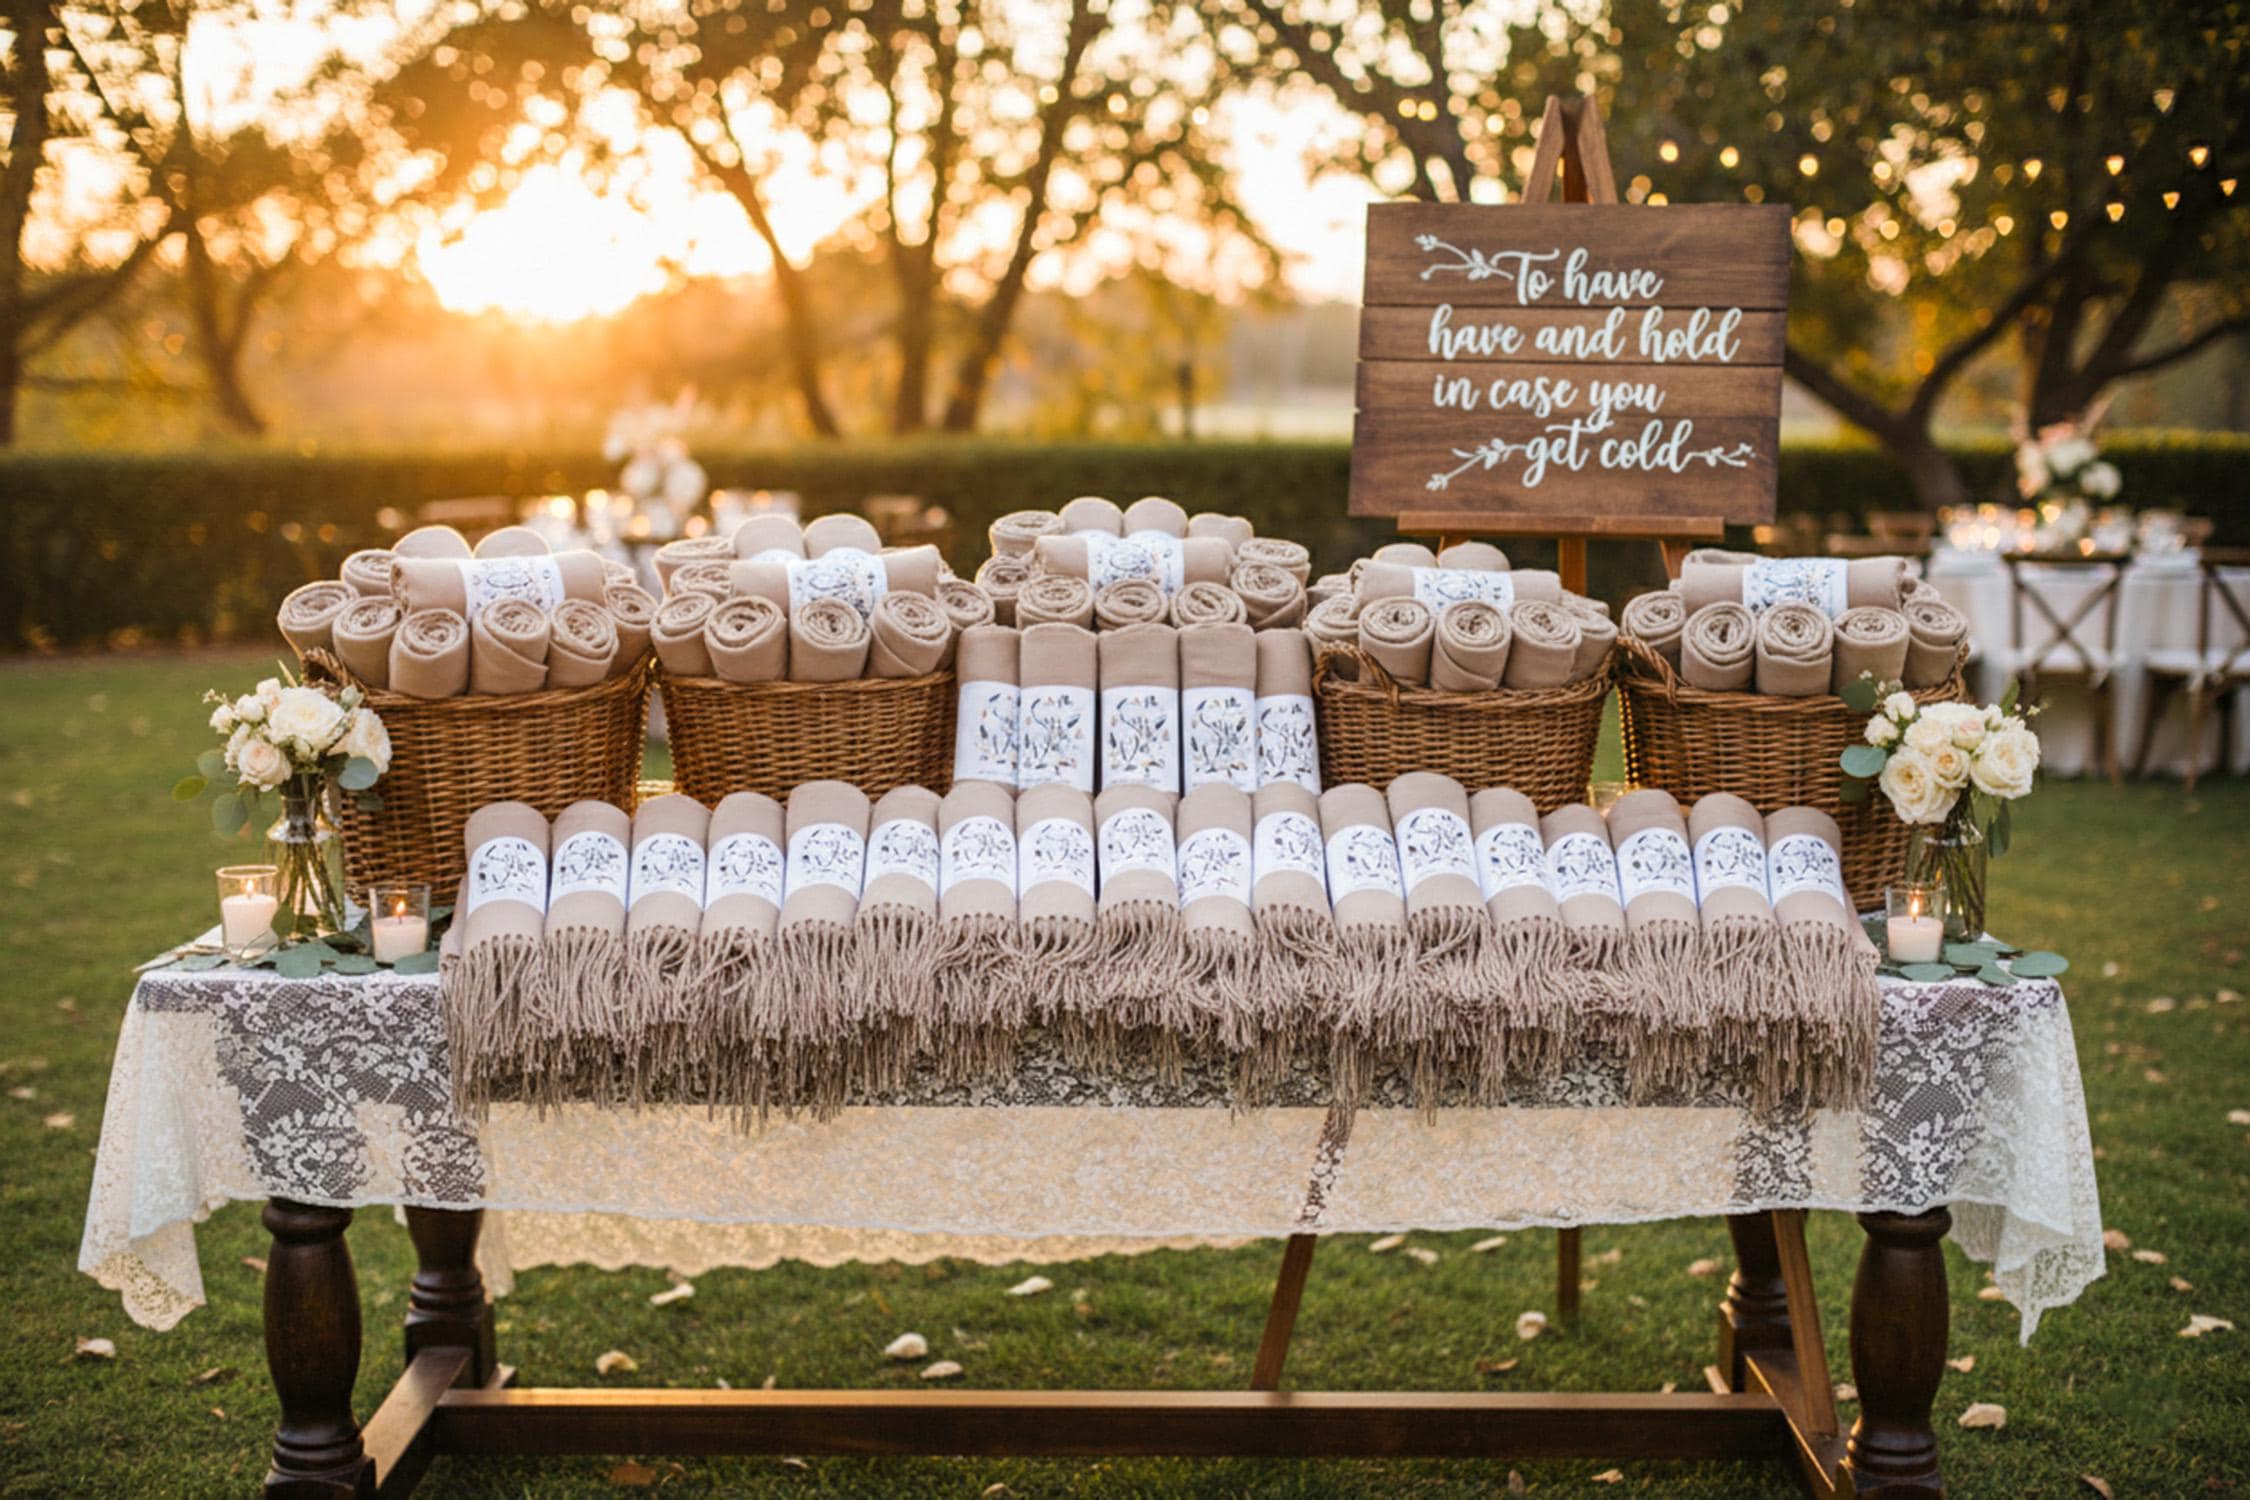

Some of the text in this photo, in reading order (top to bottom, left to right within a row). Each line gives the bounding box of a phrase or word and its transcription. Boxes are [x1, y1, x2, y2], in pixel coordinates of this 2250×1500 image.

[1491, 247, 1664, 306] To have
[1429, 304, 1742, 363] have and hold
[1433, 374, 1665, 432] in case you
[1523, 419, 1696, 488] get cold
